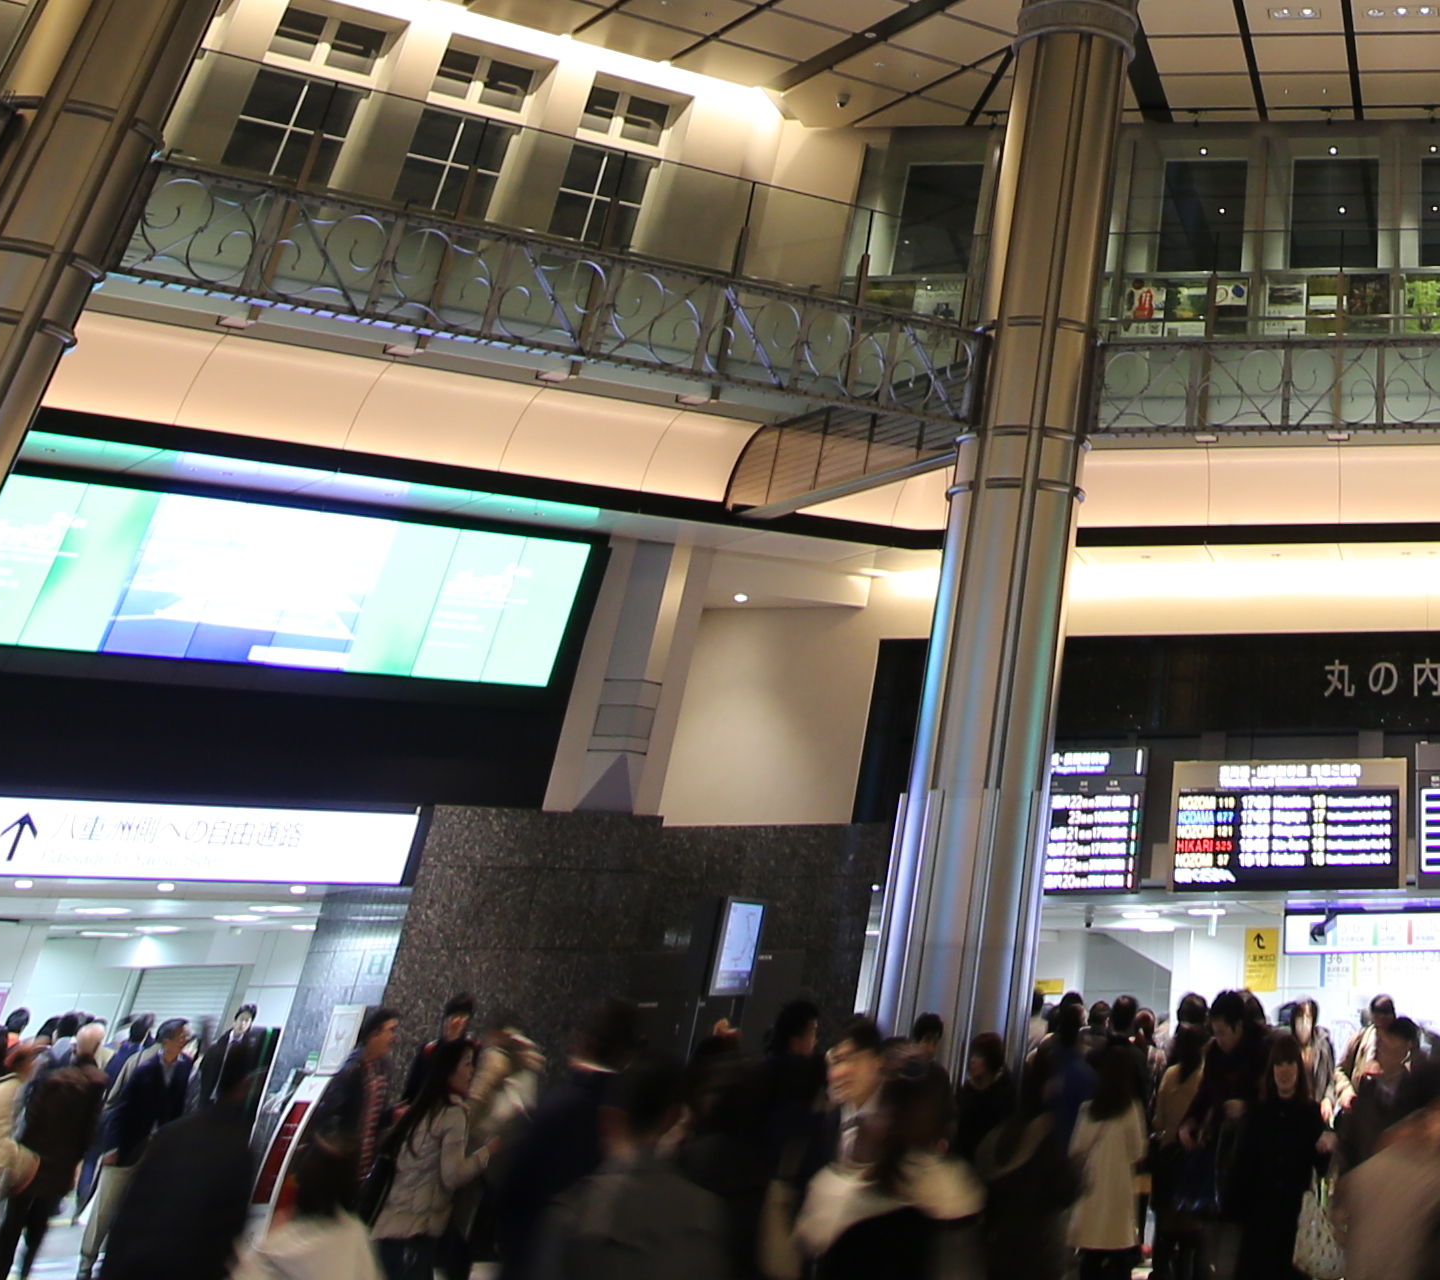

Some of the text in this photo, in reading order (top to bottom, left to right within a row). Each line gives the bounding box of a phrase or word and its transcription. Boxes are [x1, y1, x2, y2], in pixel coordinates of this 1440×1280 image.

[51, 813, 305, 848] 八重洲側への自由通路
[1175, 839, 1214, 852] HIKARI
